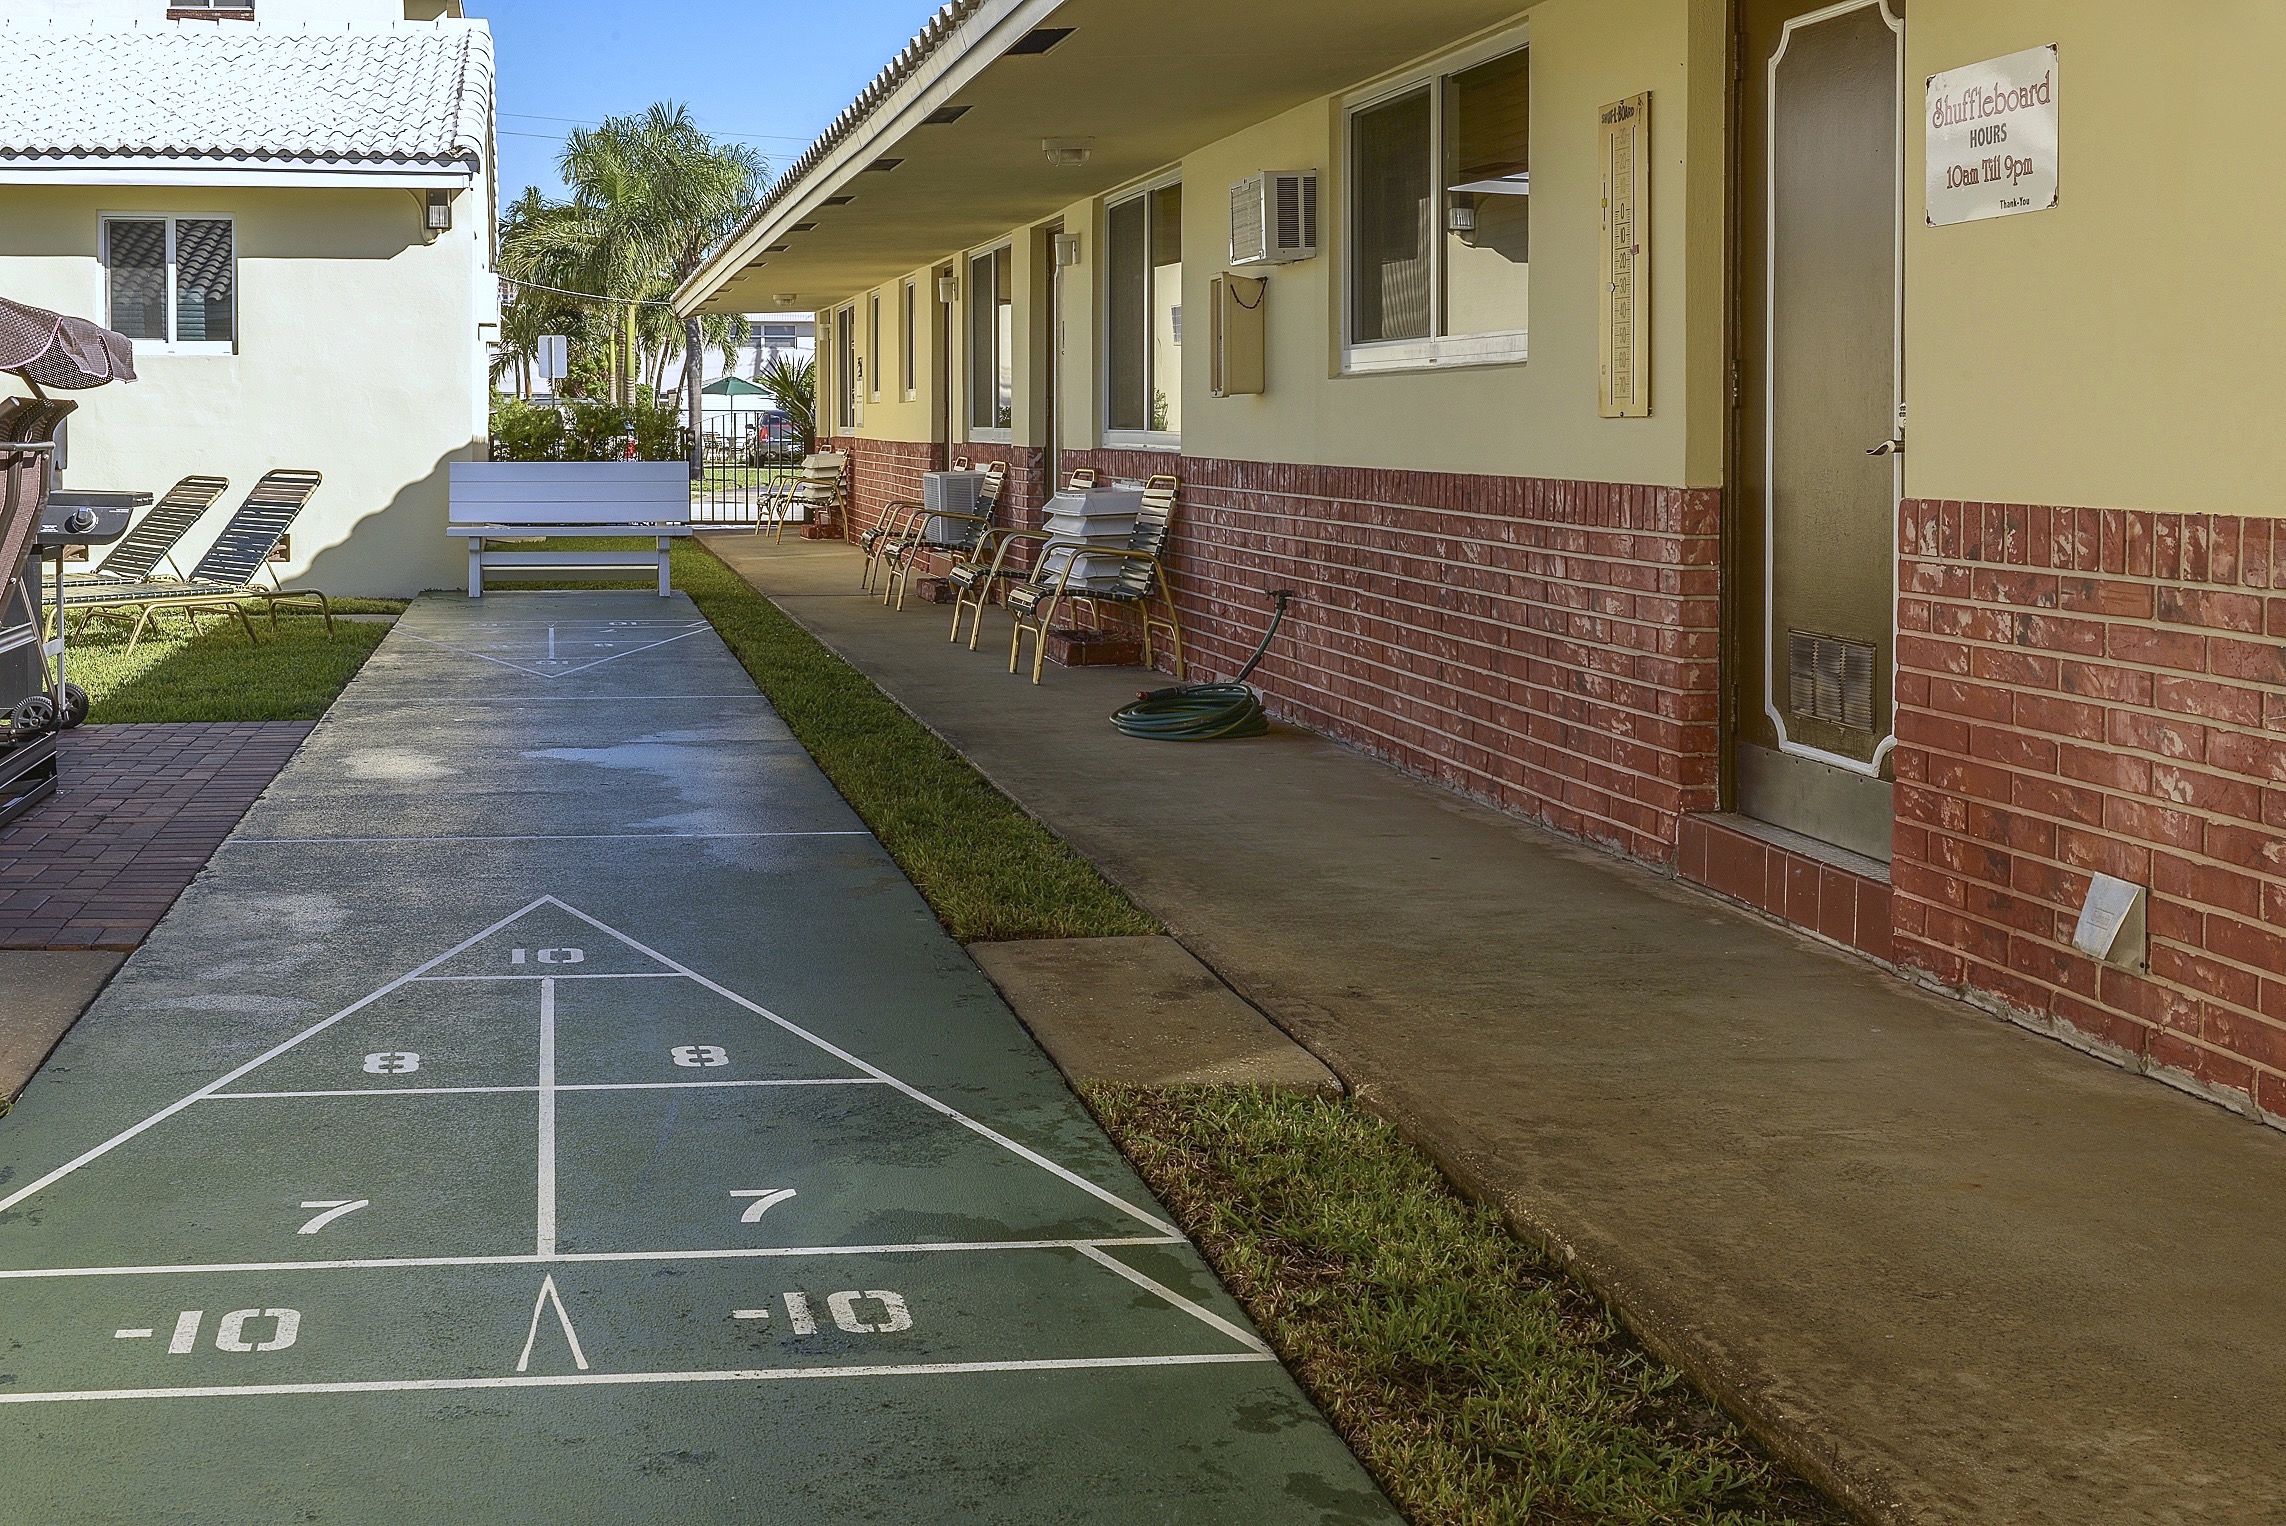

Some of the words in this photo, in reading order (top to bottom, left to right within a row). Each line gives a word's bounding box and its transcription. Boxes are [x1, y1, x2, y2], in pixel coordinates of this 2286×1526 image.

[1932, 70, 2051, 129] Shuffleboard
[1970, 123, 2007, 148] HOURS
[1946, 165, 1980, 189] 10am
[1982, 155, 2001, 183] Till
[2004, 155, 2034, 186] 9pm
[1620, 203, 1625, 219] 0
[1620, 227, 1626, 243] 10
[1620, 252, 1627, 269] 20
[1620, 277, 1627, 294] 30
[1620, 301, 1627, 319] 40
[512, 947, 585, 965] 10
[363, 1052, 421, 1075] 8
[670, 1045, 729, 1068] 8
[296, 1199, 369, 1235] 7
[729, 1188, 797, 1223] 7
[732, 1290, 913, 1335] -10
[114, 1307, 301, 1355] -10
